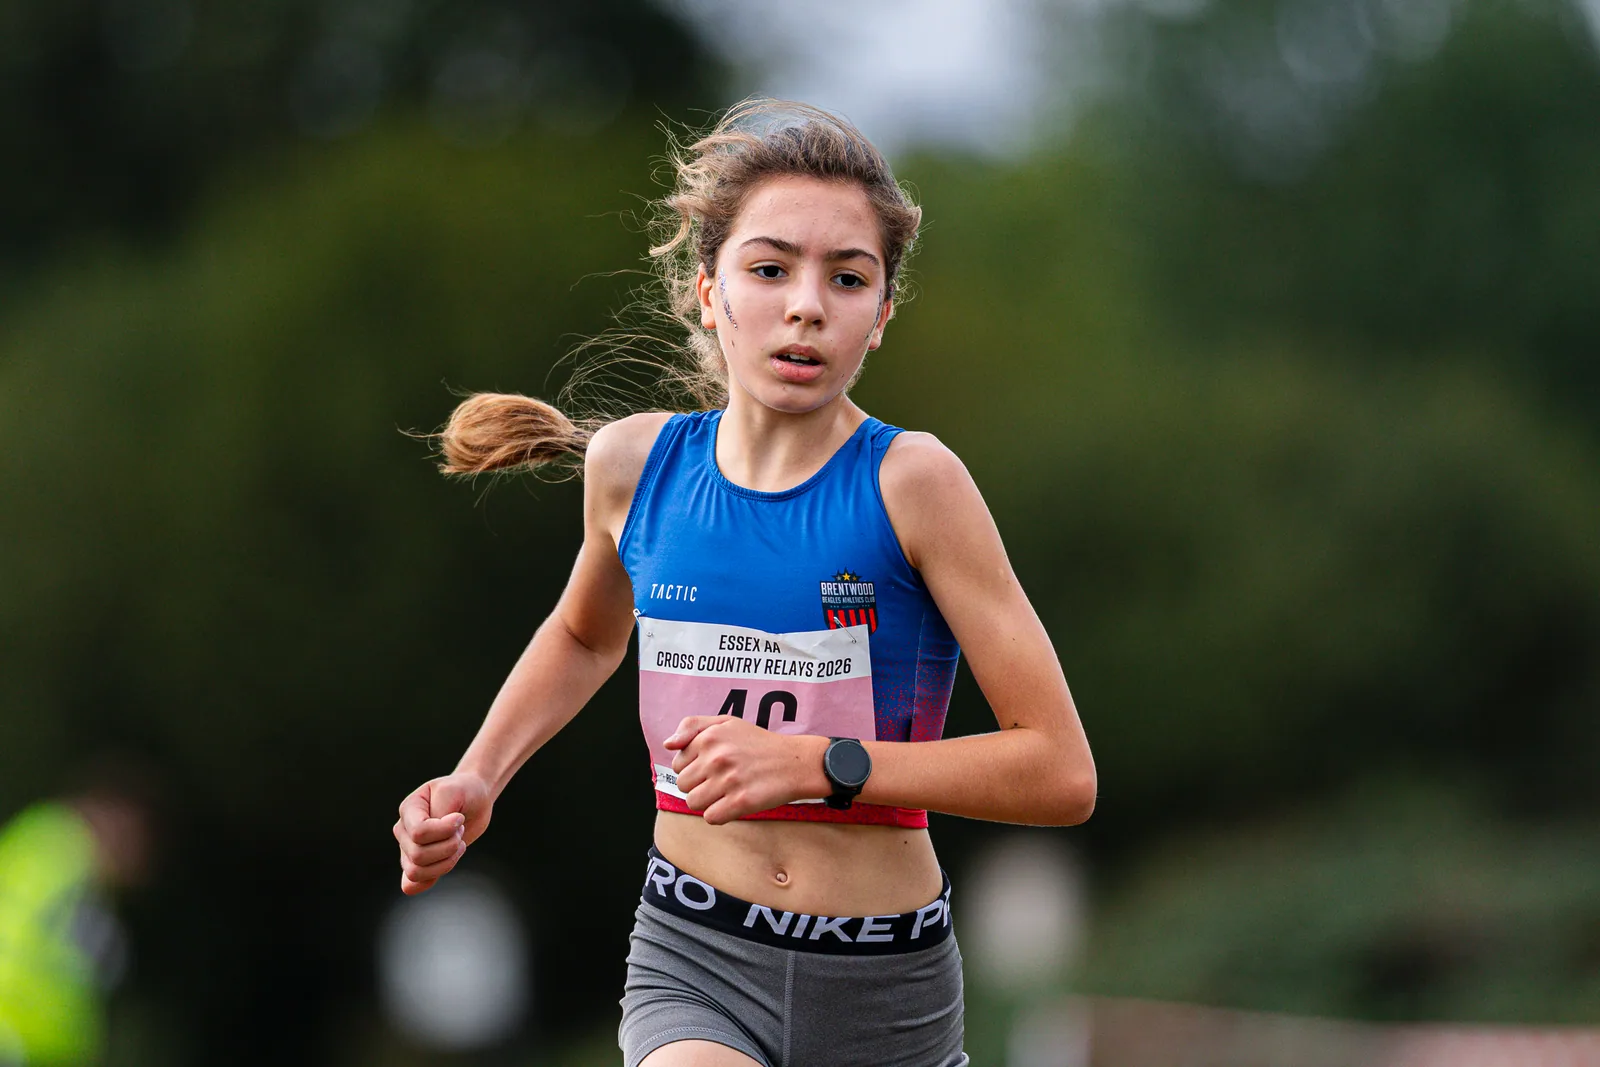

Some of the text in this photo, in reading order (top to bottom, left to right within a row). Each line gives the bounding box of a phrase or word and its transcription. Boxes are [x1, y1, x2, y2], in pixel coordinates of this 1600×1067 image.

[650, 583, 698, 602] TACTIC
[820, 582, 875, 596] BRENTWOOD
[822, 596, 842, 604] BEAGLES
[842, 596, 865, 604] ATHLETICS
[719, 634, 781, 654] ESSEX AA
[656, 651, 852, 678] CROSS COUNTRY RELAYS 2026
[646, 856, 717, 911] RO
[743, 903, 901, 943] NIKE
